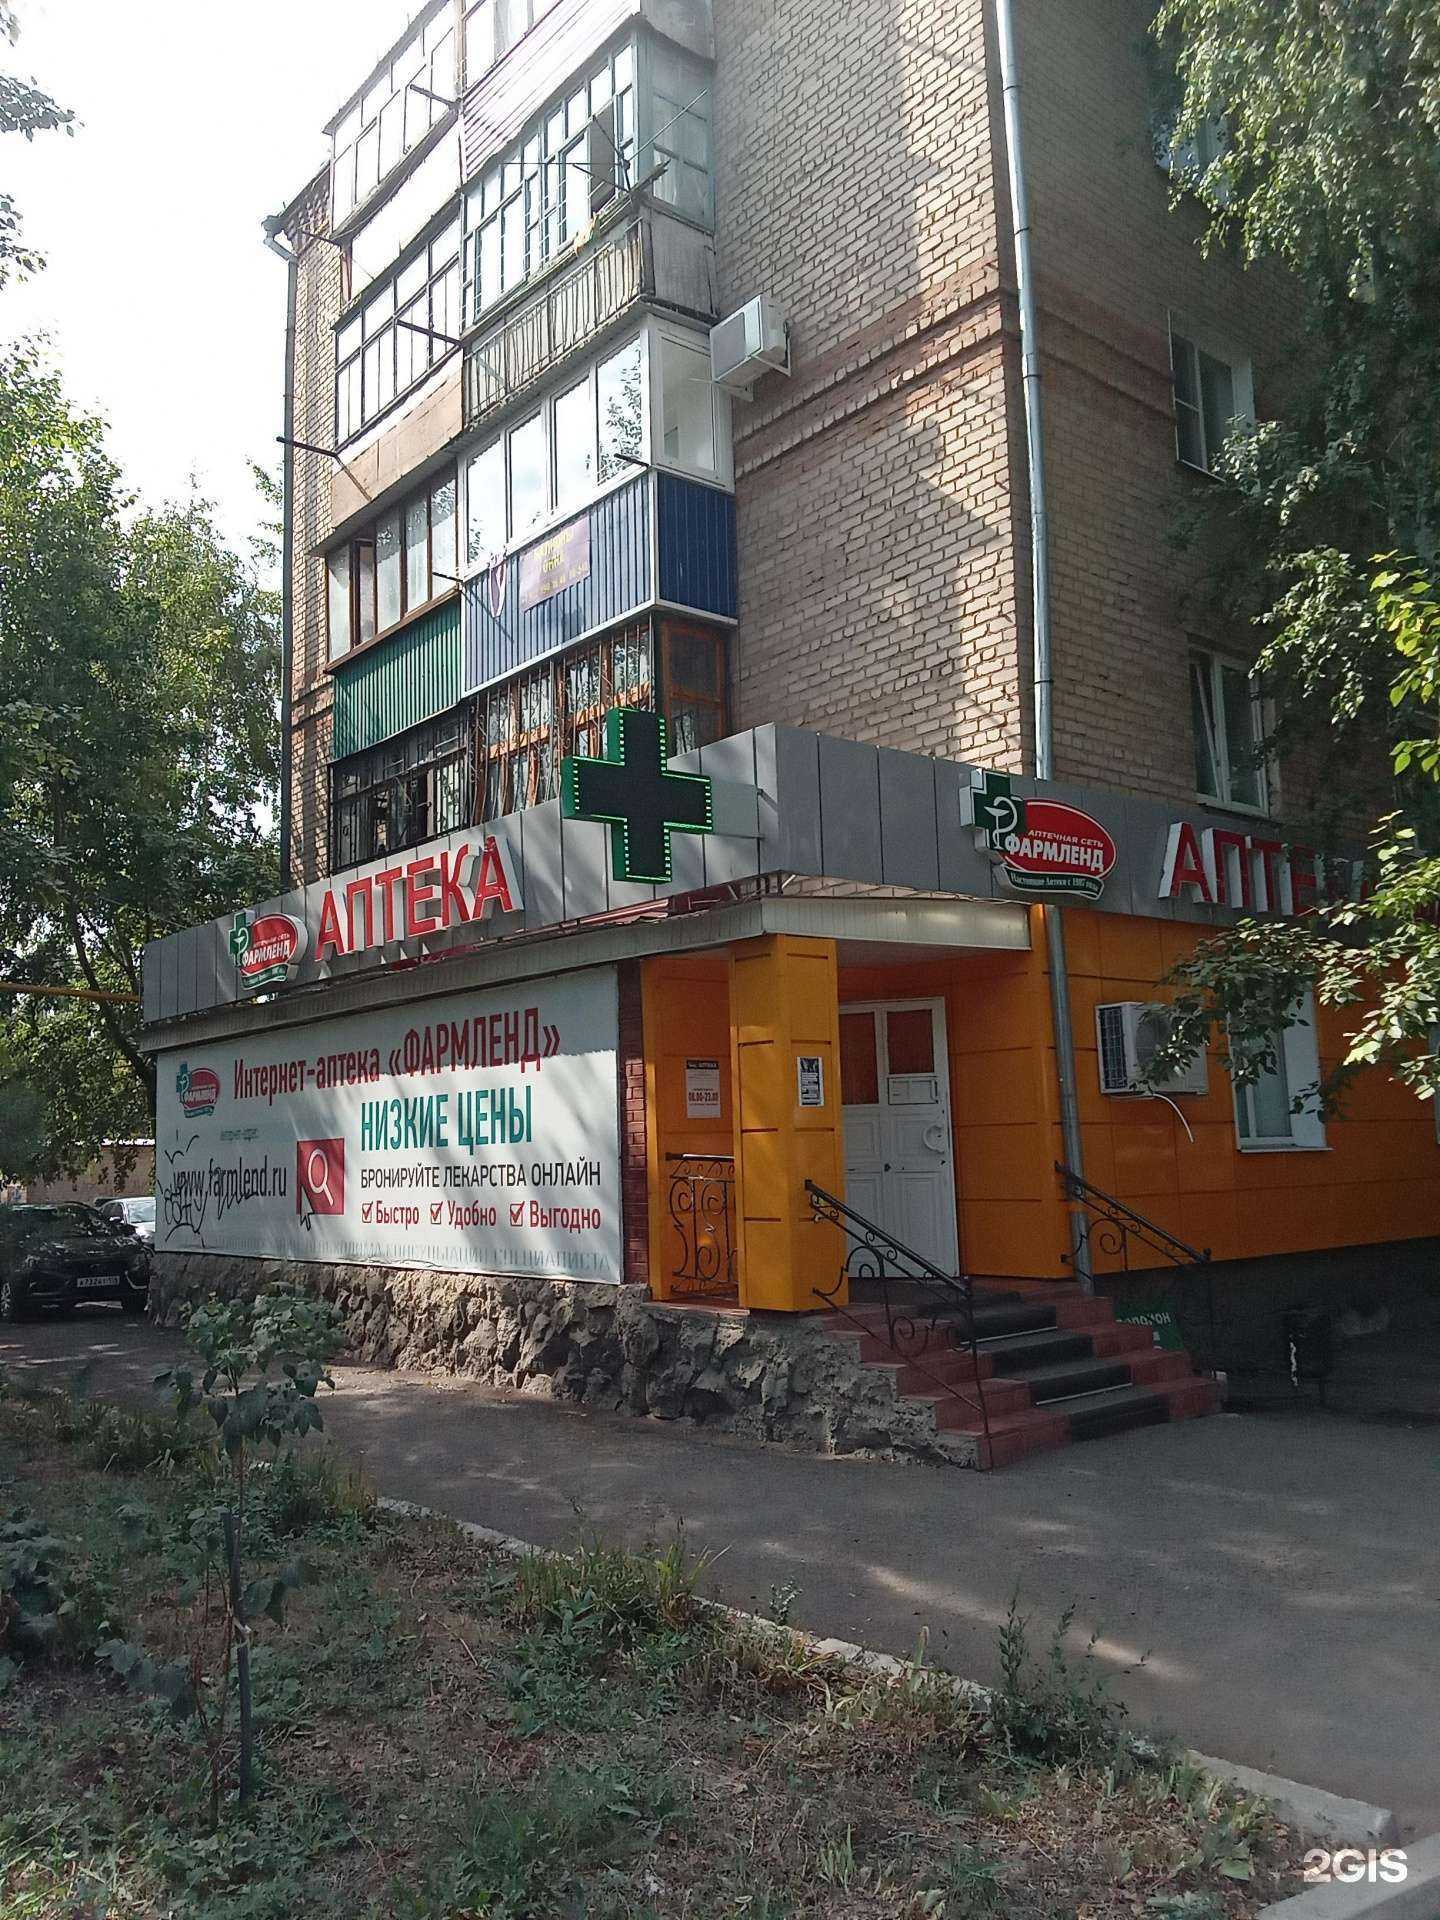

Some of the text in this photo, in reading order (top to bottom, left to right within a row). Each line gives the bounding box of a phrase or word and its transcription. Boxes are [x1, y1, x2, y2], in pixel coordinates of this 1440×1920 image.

[1004, 833, 1104, 872] ФАРМЛЕНД
[1028, 829, 1104, 848] АПТЕЧНАЯ СЕТЬ
[1158, 822, 1380, 918] АПТЕ
[315, 836, 522, 962] АПТЕКА
[242, 940, 290, 967] ФАРМЛЕНД
[234, 1007, 560, 1106] Интернет-аптека «ФАРМЛЕНД»
[361, 1085, 532, 1155] НИЗКИЕ ЦЕНЫ
[173, 1155, 287, 1197] www.farmlend.ru
[361, 1158, 601, 1189] БРОНИРУЙТЕ ЛЕКАРСТВА ОНЛАЙН
[376, 1200, 601, 1232] Быстро Удобно Выгодно
